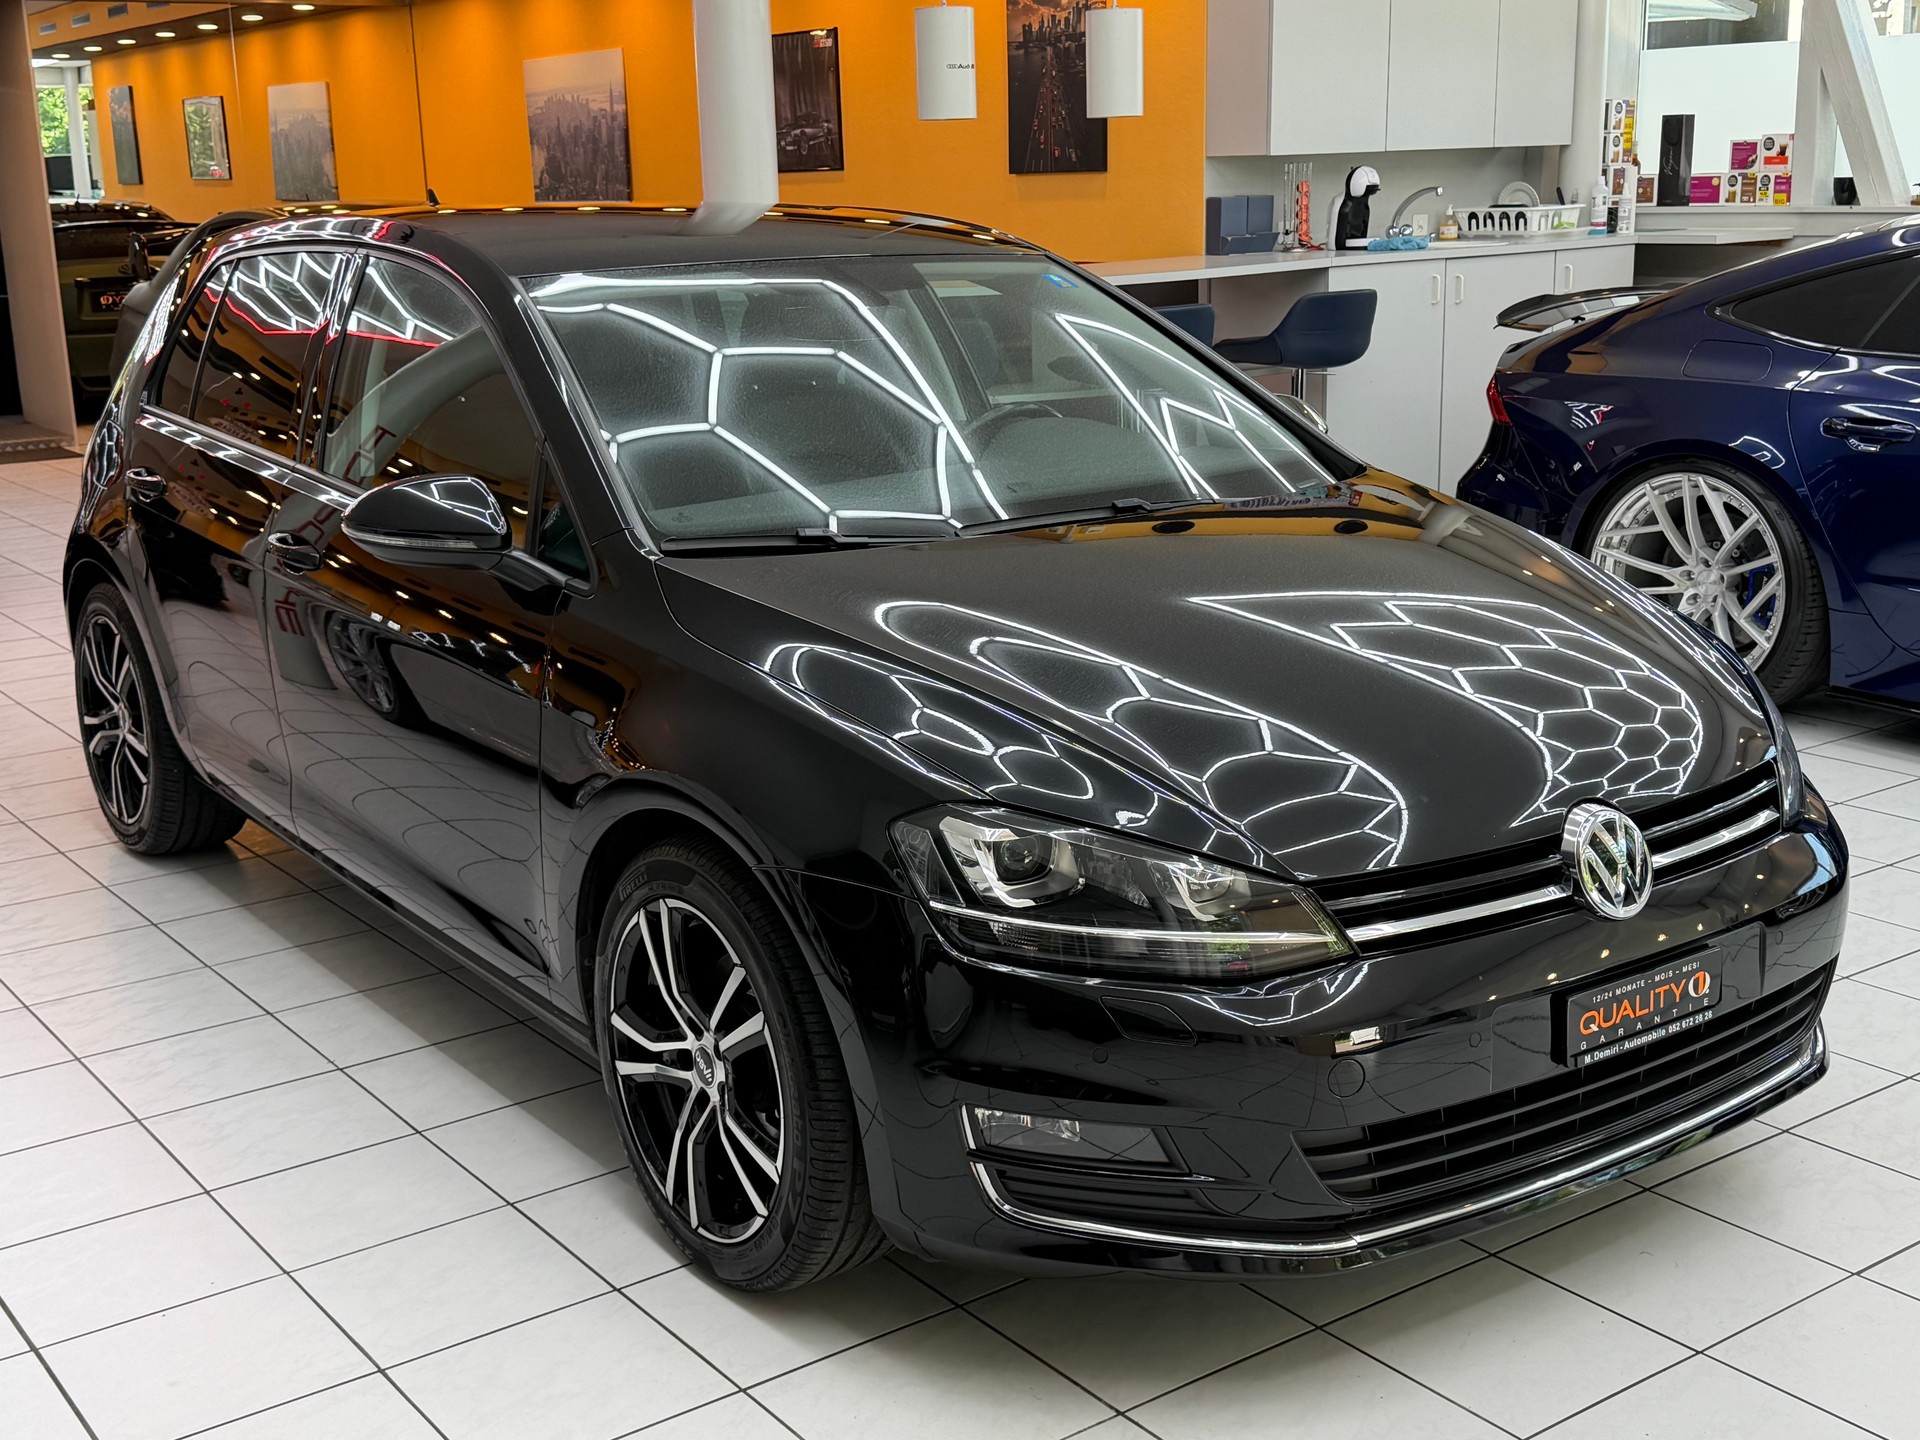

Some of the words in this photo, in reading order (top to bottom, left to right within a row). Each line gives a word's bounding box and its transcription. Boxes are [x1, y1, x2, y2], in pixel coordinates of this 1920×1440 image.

[618, 865, 648, 902] PIRELLI
[1592, 990, 1613, 1003] 12/24
[1615, 979, 1645, 996] MONATE
[1654, 970, 1673, 982] MOIS
[1682, 961, 1700, 973] MESI
[1579, 978, 1687, 1035] QUALITY
[1580, 998, 1709, 1050] GARANTIE
[1594, 1044, 1619, 1060] Demiri
[1668, 1022, 1681, 1033] 052
[1682, 1017, 1694, 1028] 672
[788, 1156, 806, 1227] P7
